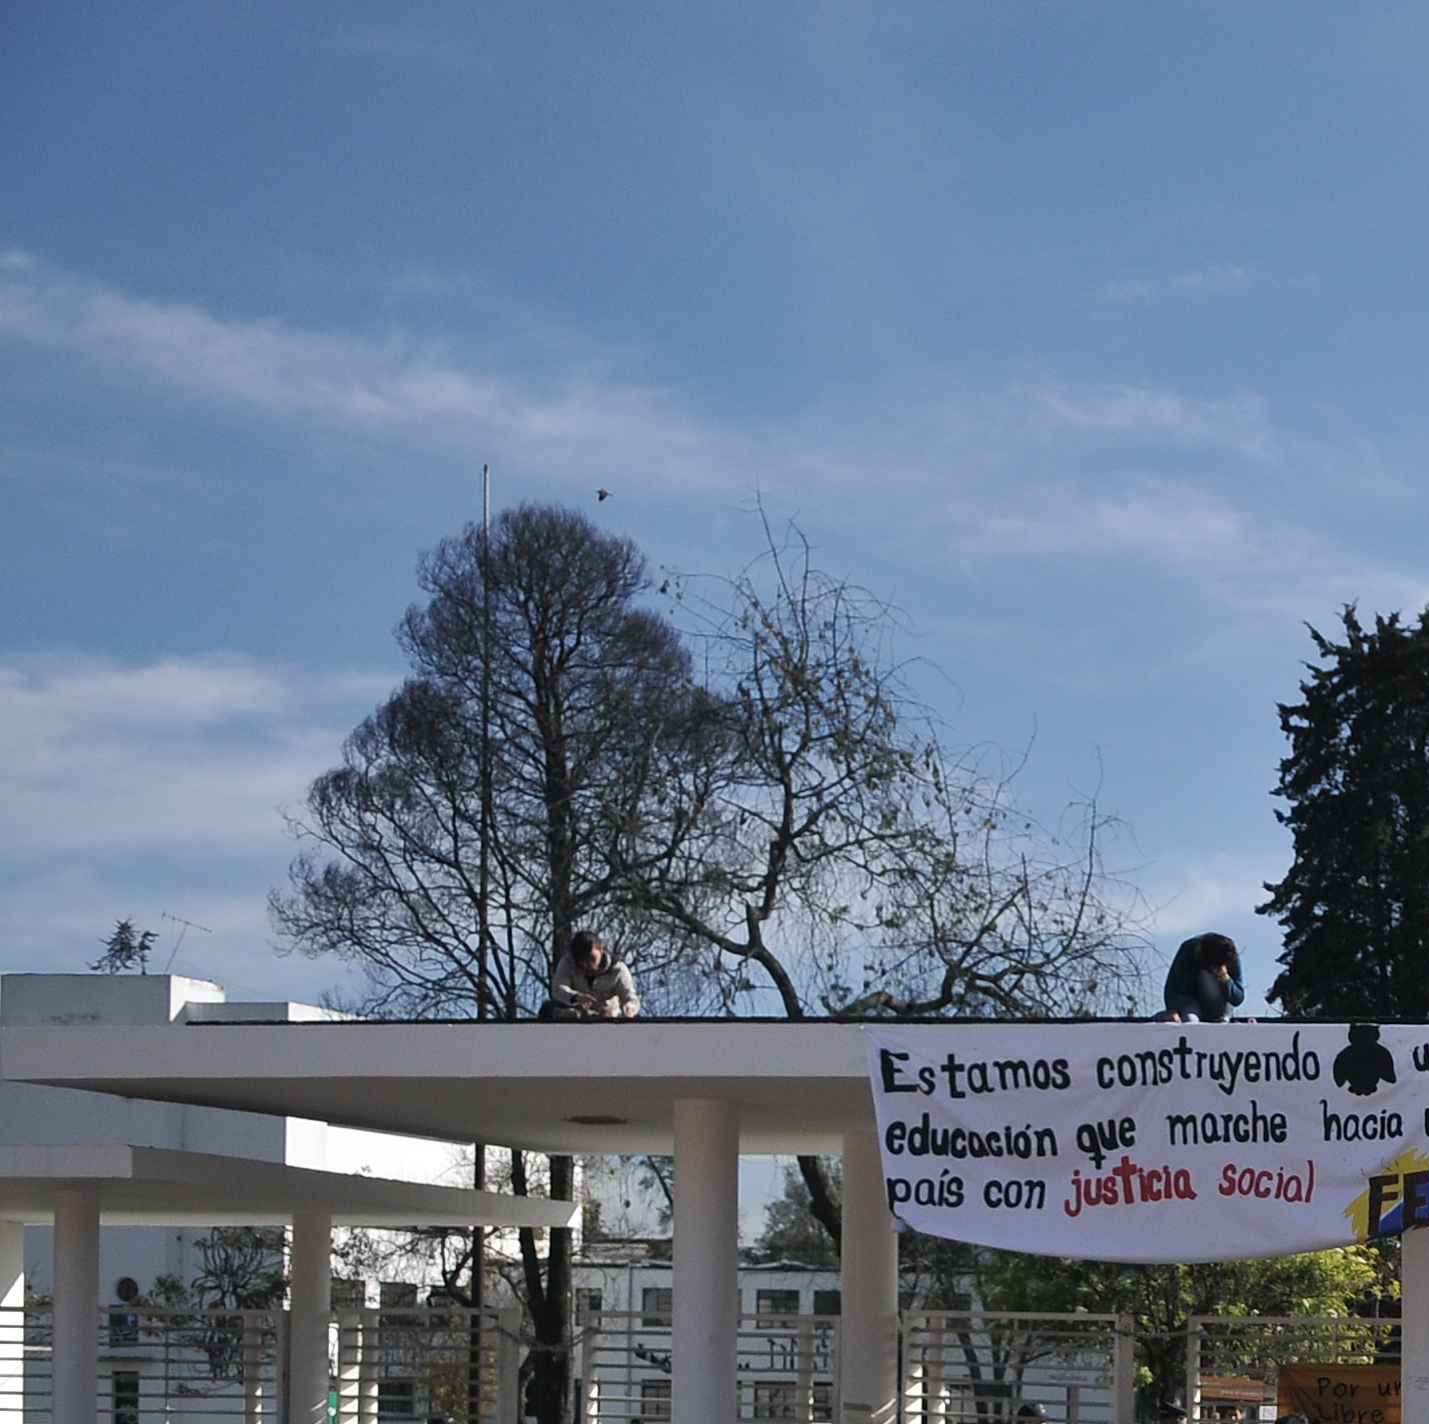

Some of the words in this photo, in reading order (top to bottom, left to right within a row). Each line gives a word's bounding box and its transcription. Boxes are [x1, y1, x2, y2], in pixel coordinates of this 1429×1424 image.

[880, 1048, 1071, 1098] Estamos
[1096, 1031, 1320, 1095] construyendo
[885, 1113, 1058, 1159] educación
[1076, 1117, 1136, 1170] que
[1166, 1100, 1288, 1145] marche
[1320, 1099, 1403, 1141] hacia
[887, 1168, 965, 1218] país
[983, 1179, 1046, 1209] con
[1064, 1156, 1198, 1217] justicia
[1218, 1160, 1315, 1203] social
[1316, 1377, 1359, 1398] Por
[1318, 1403, 1385, 1424] Libre
